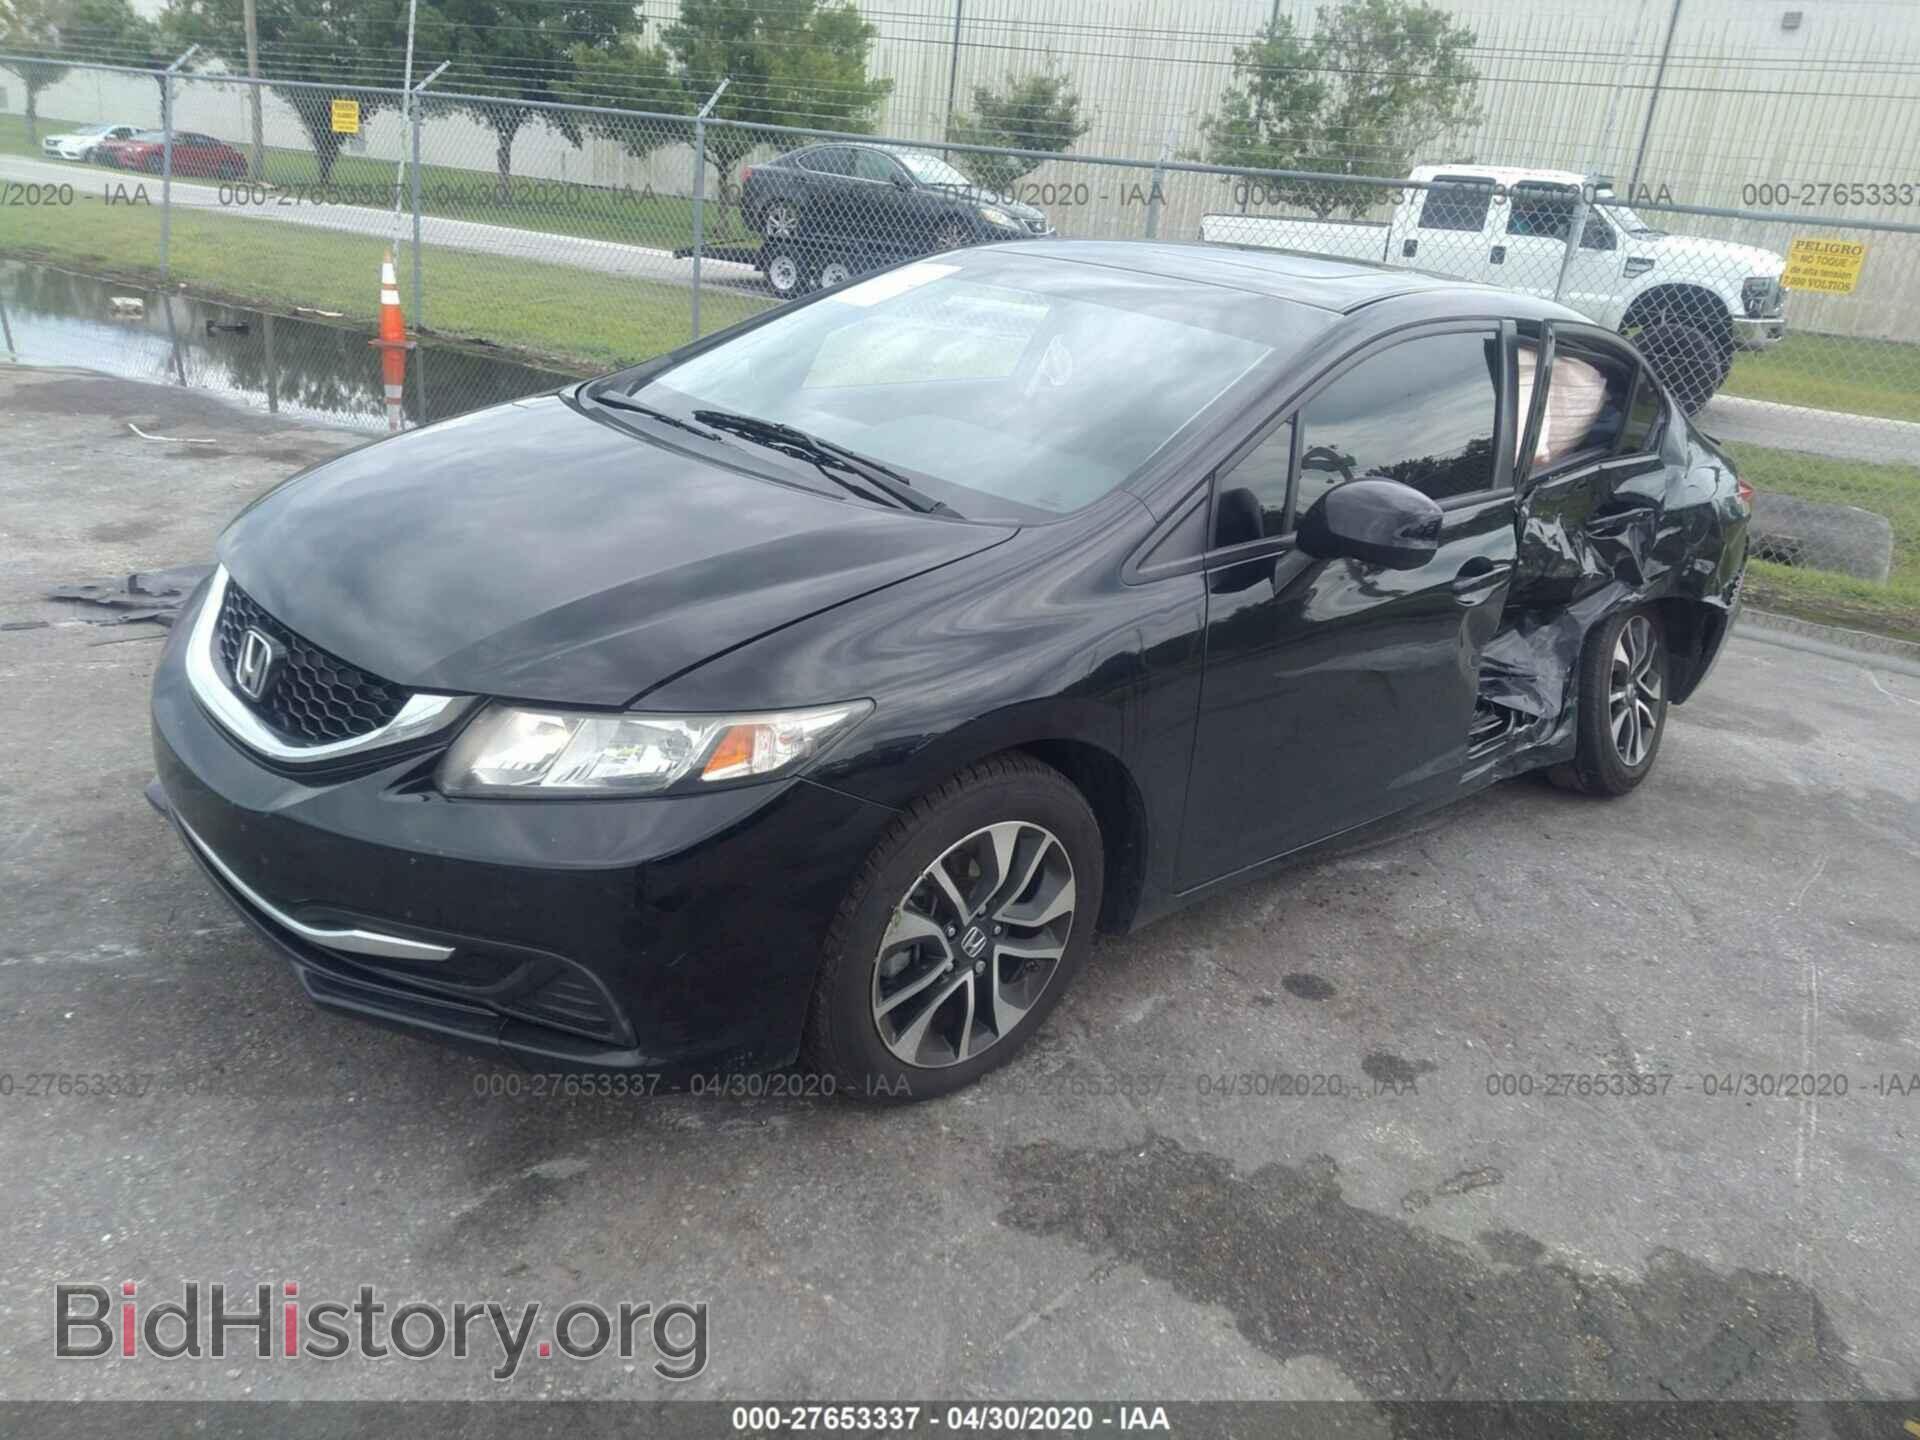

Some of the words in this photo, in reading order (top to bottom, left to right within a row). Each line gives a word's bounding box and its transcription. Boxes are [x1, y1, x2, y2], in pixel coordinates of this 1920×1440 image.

[1795, 240, 1863, 256] PELIGRO
[1800, 255, 1814, 265] NO
[1816, 255, 1848, 268] TOQUE
[1807, 278, 1851, 291] VOLTIOS
